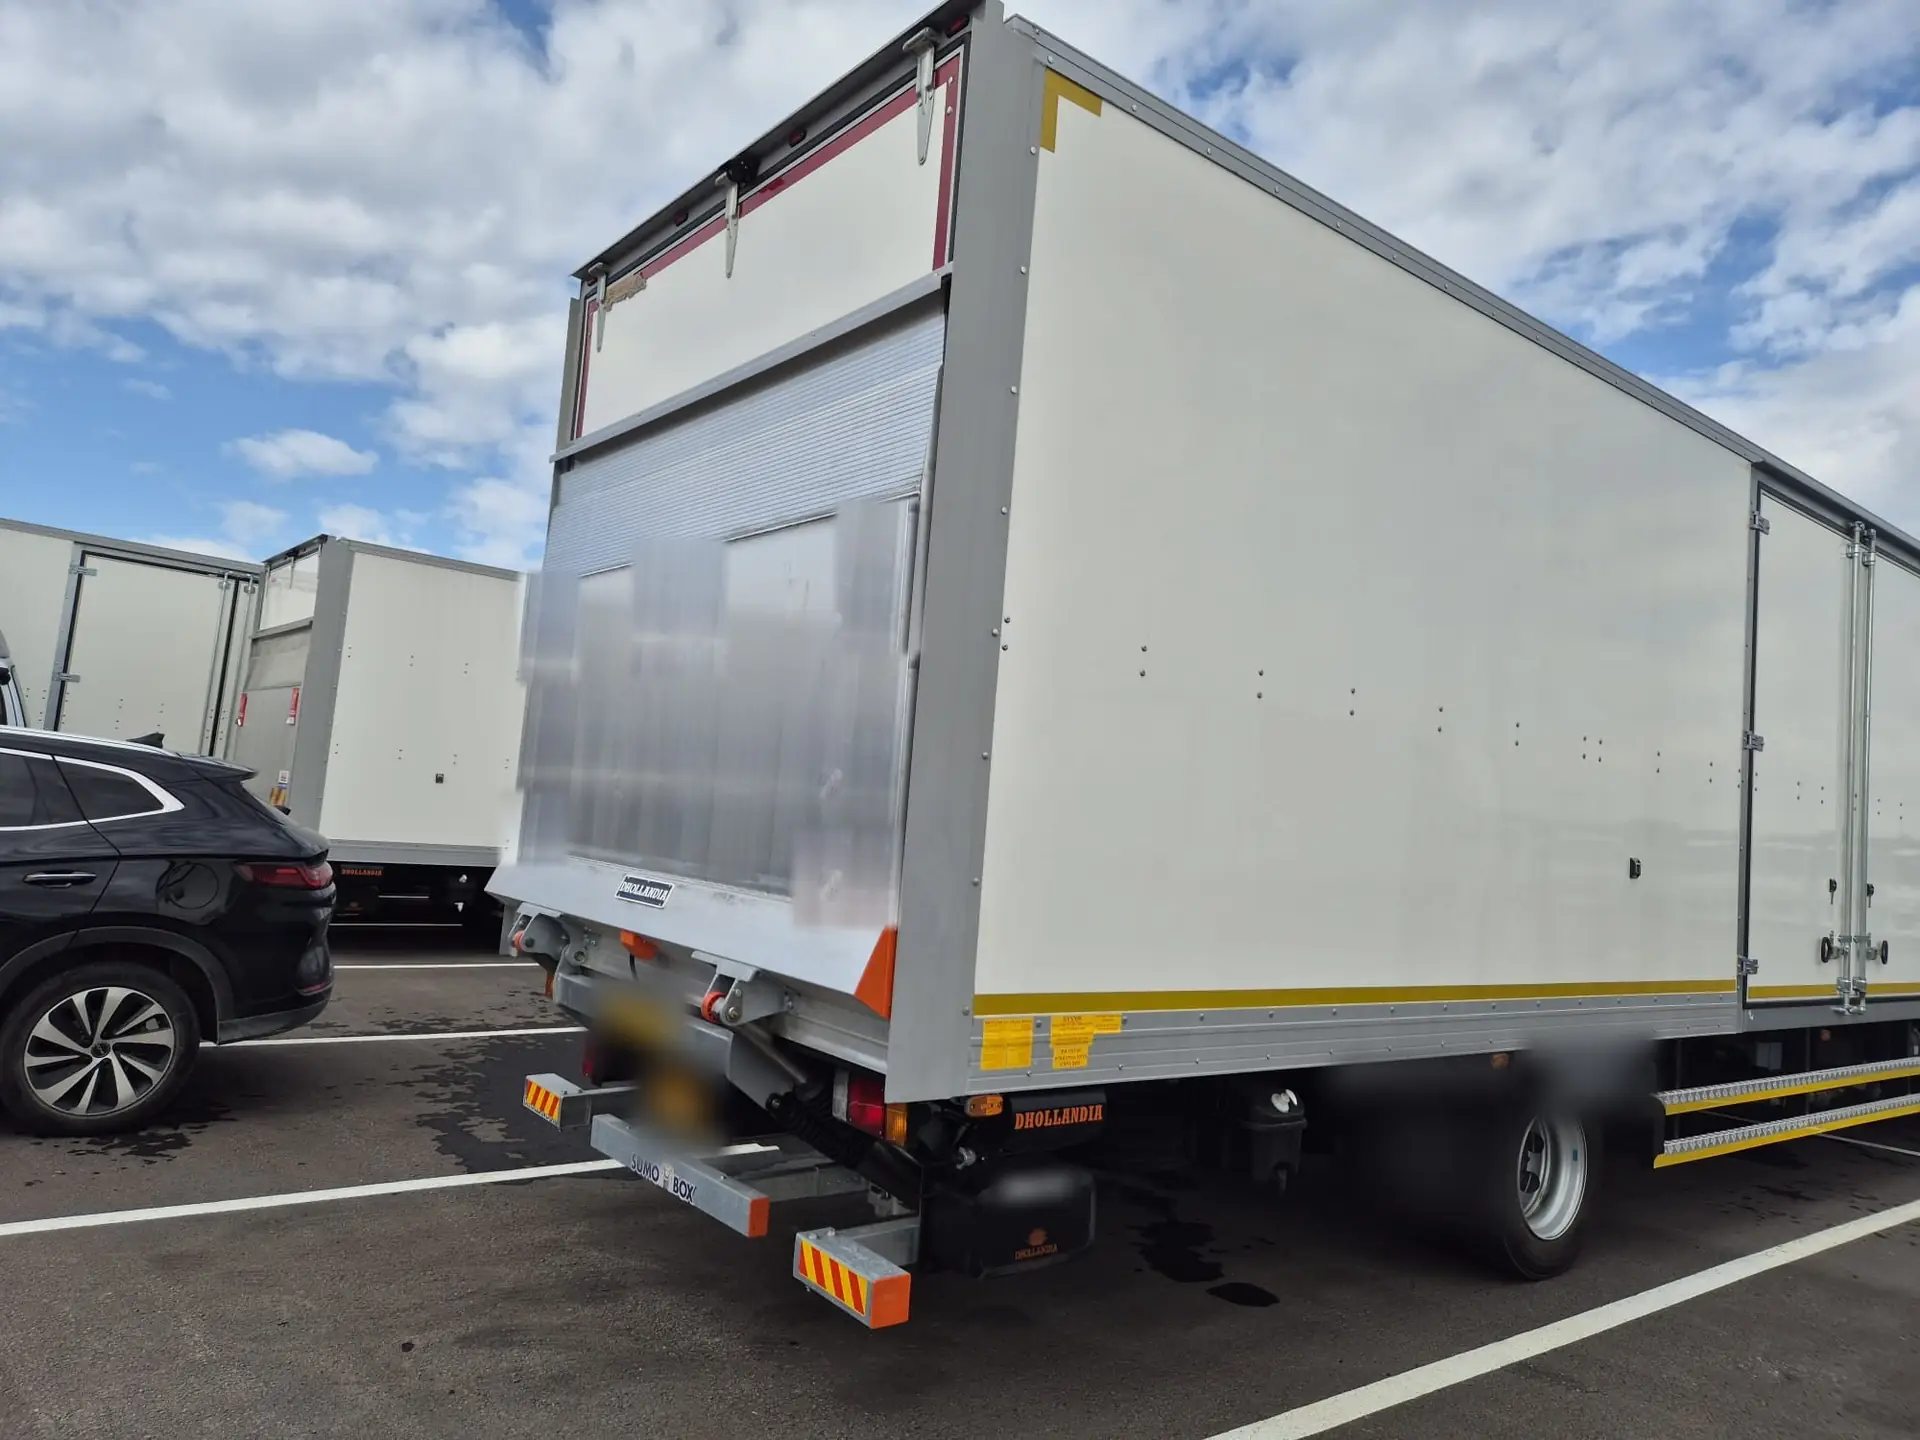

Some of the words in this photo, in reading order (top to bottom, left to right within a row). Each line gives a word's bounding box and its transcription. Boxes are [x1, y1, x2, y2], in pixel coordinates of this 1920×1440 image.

[619, 881, 669, 901] DHOLLANDIA
[1014, 1104, 1103, 1130] DHOLLANDIA
[631, 1153, 660, 1182] SUMO
[673, 1176, 694, 1203] BOX
